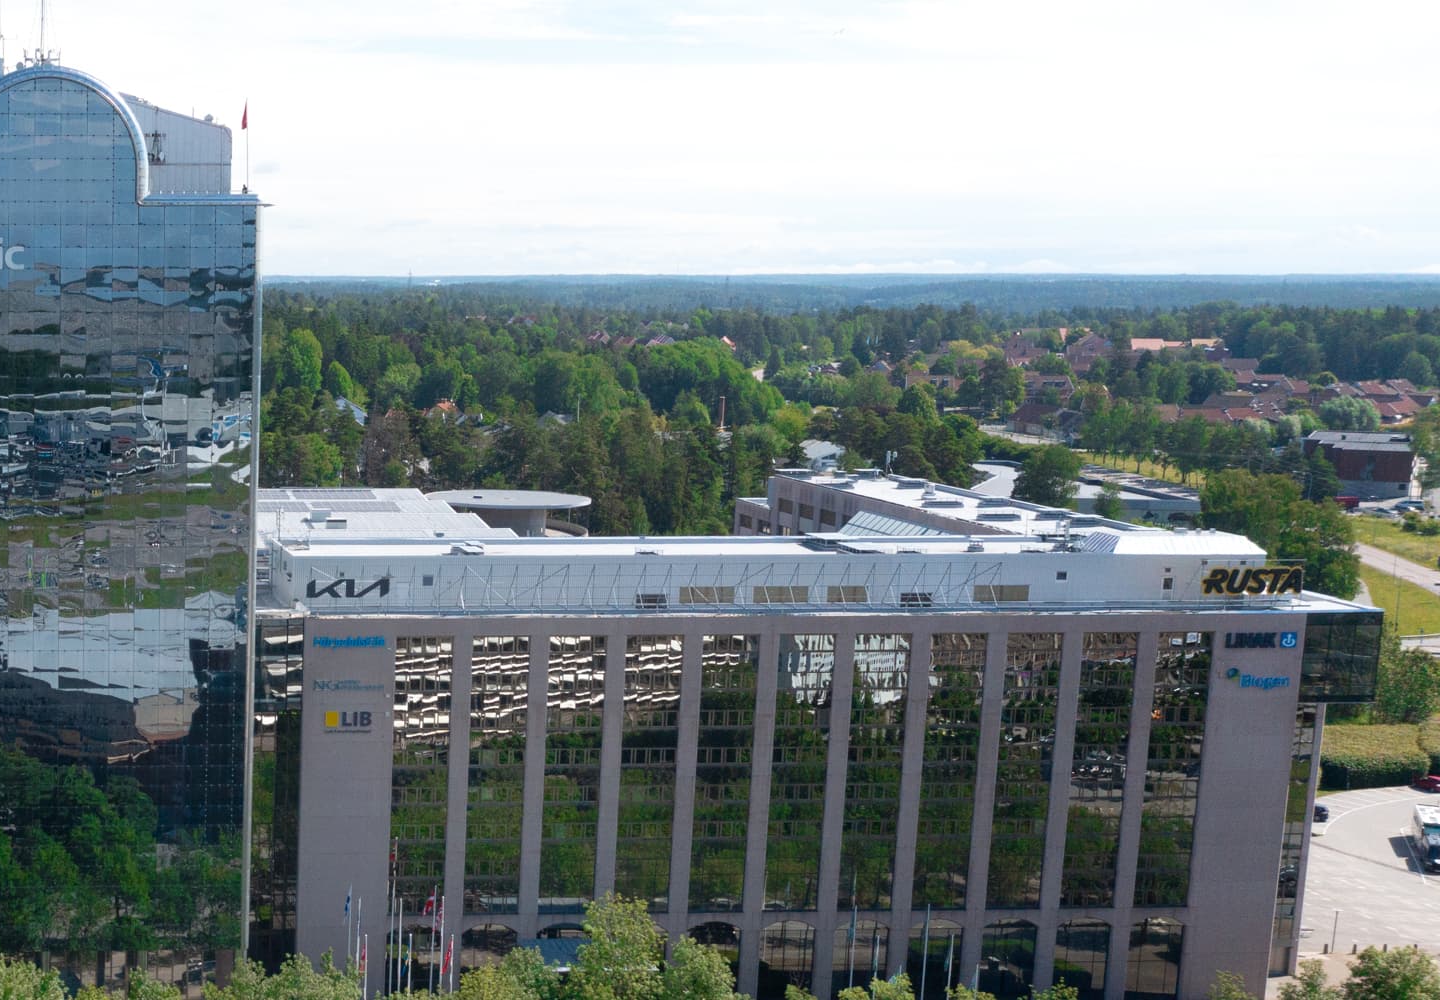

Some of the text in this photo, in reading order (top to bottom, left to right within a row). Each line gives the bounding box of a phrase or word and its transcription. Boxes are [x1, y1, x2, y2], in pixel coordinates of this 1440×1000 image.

[1202, 566, 1303, 595] RUSTA
[1240, 674, 1290, 691] Biogen
[342, 711, 372, 727] LIB
